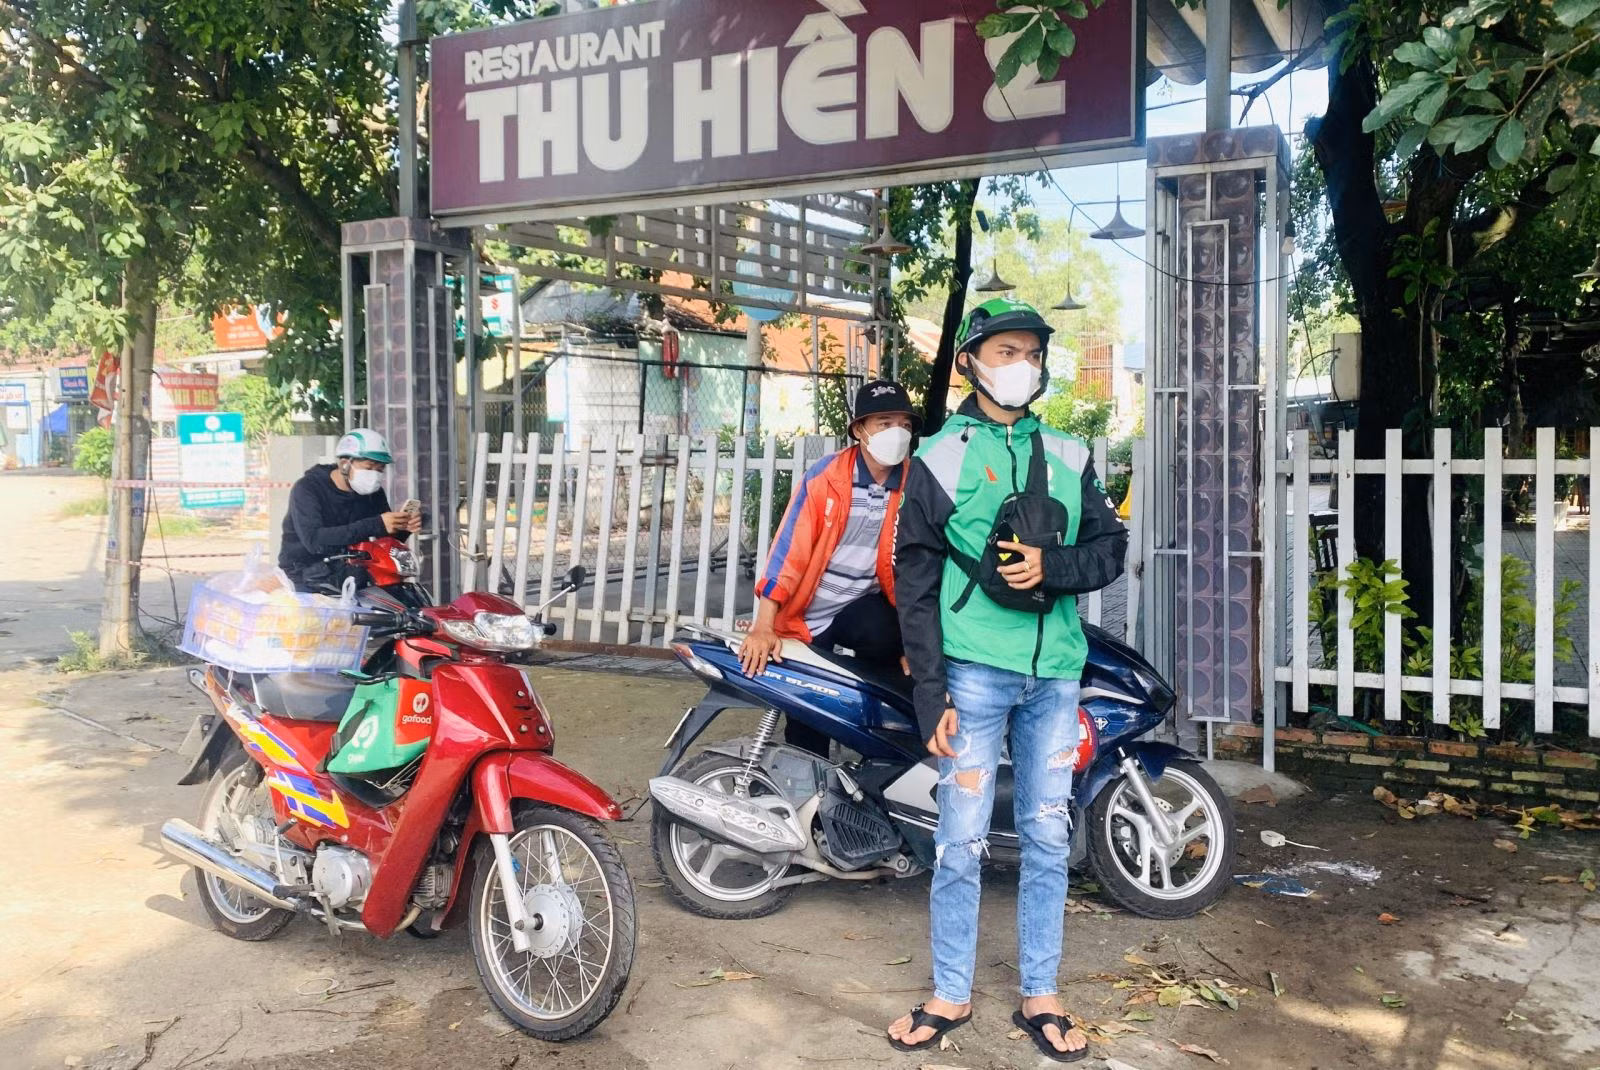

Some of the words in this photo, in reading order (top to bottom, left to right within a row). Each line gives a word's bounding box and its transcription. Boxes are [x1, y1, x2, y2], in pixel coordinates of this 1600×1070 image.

[464, 20, 666, 85] RESTAURANT
[465, 67, 649, 183] THU
[673, 0, 955, 163] HIỀN
[402, 715, 432, 724] gofood
